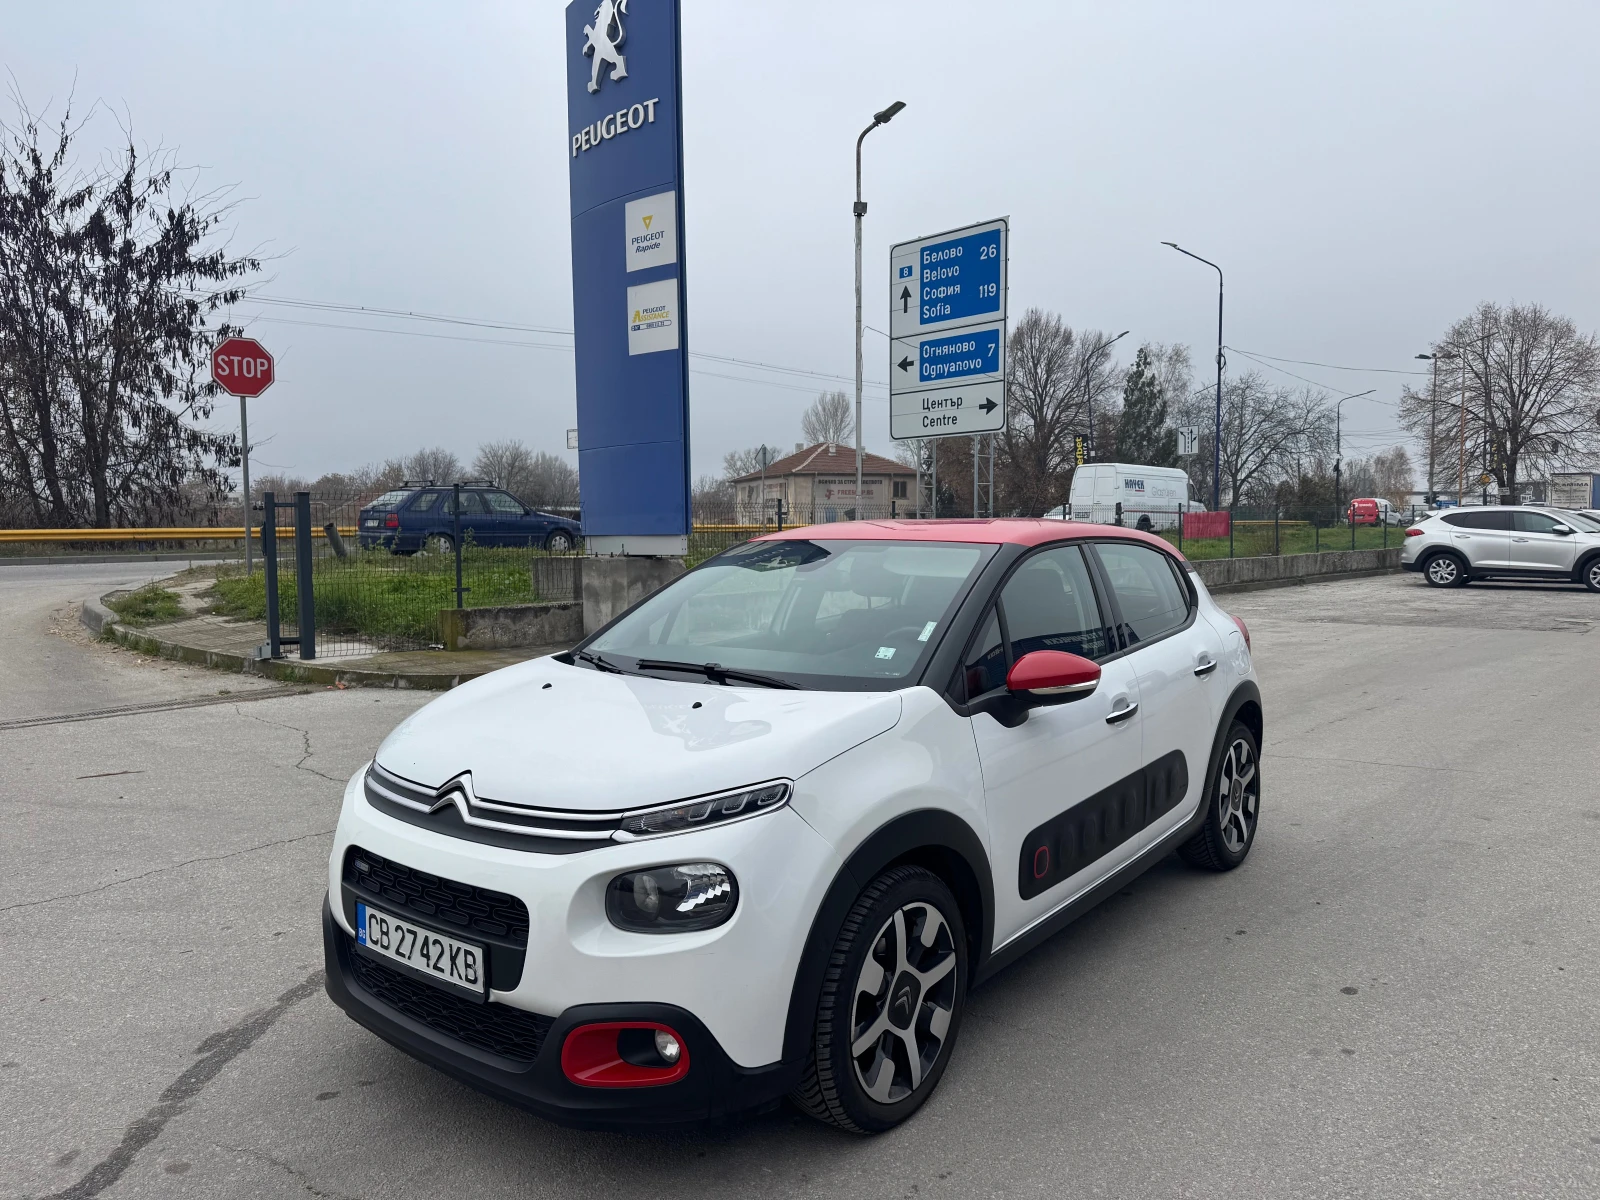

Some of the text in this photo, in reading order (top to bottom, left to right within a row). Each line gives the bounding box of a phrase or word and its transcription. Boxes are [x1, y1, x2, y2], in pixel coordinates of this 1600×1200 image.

[572, 97, 660, 158] PEUGEOT
[631, 230, 665, 245] PEUGEOT
[635, 242, 661, 254] Rapide
[923, 244, 997, 264] Белово 26
[903, 268, 909, 276] 8
[923, 265, 960, 283] Belovo
[923, 283, 997, 300] София 119
[642, 305, 666, 314] PEUGEOT
[923, 303, 951, 319] Sofia
[923, 341, 996, 358] Огняново 7
[217, 355, 269, 378] STOP
[923, 358, 982, 378] Ognyanovo
[922, 396, 963, 411] Център
[922, 413, 958, 428] Centre
[1075, 436, 1084, 465] efbet
